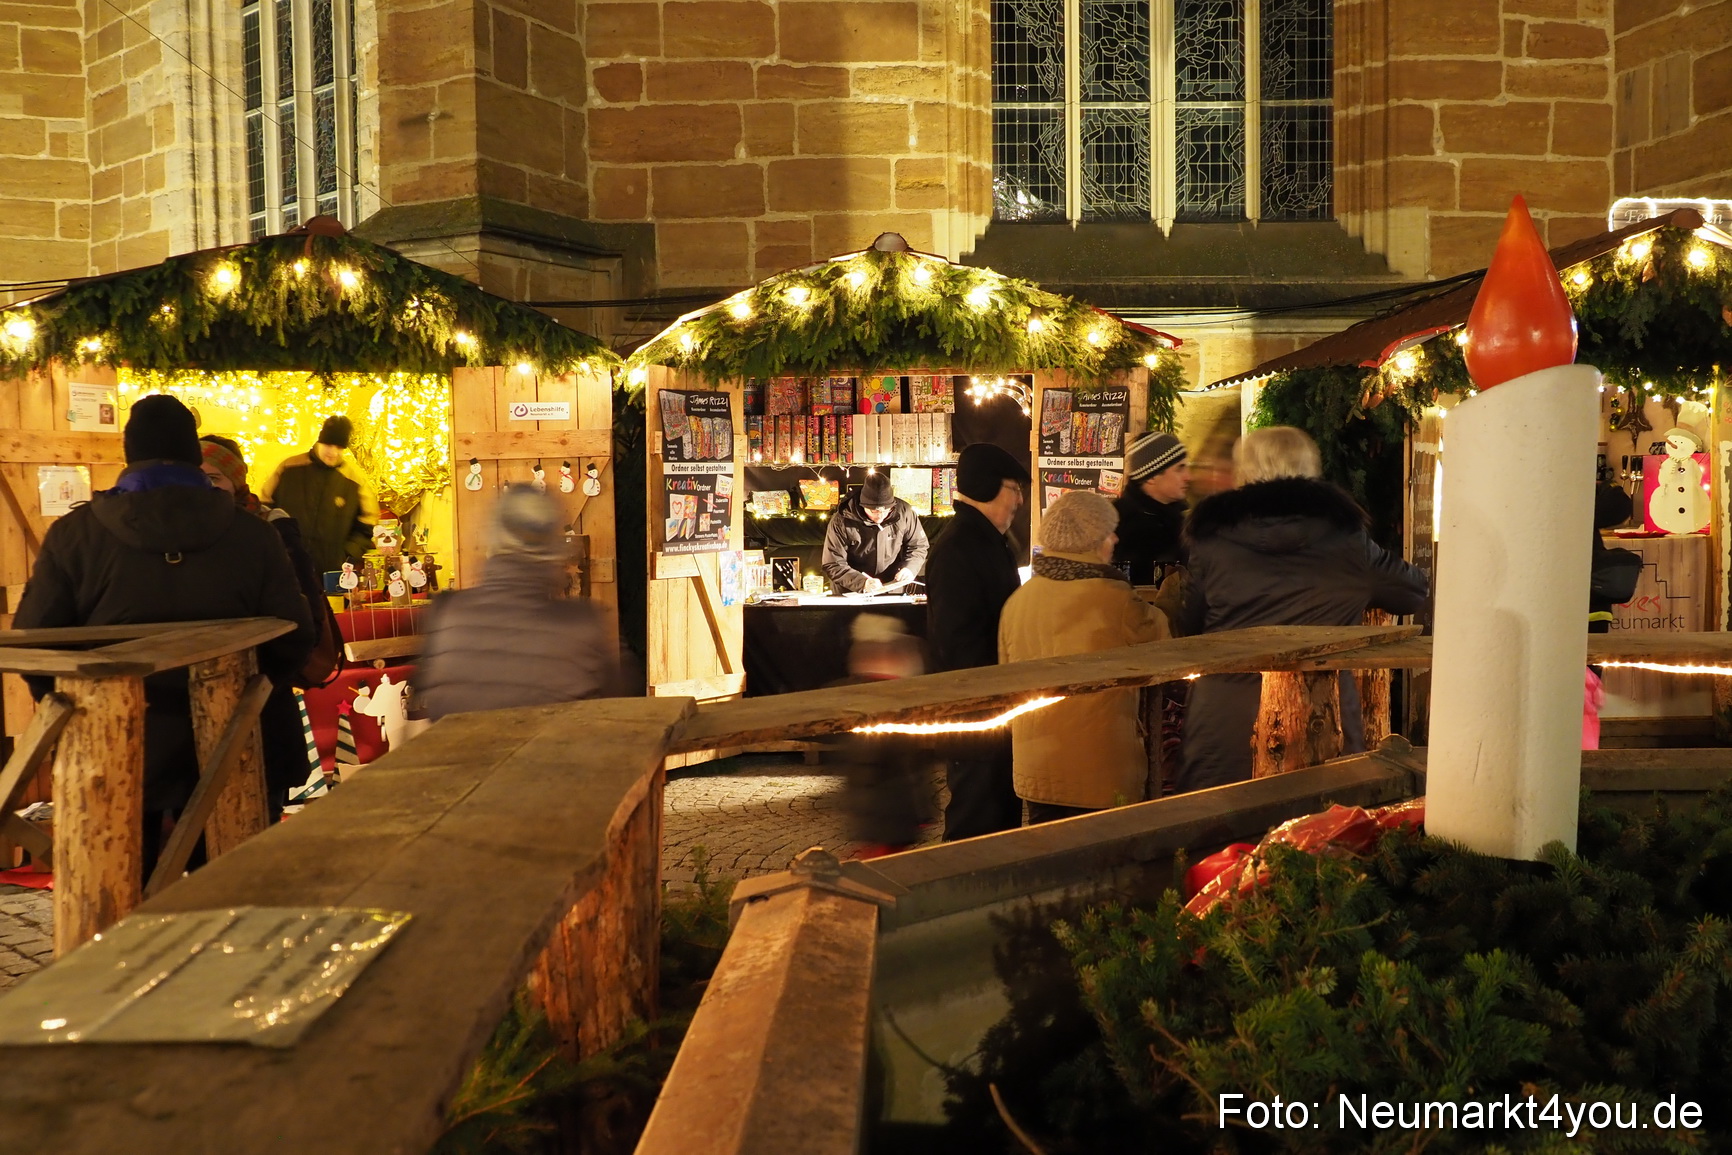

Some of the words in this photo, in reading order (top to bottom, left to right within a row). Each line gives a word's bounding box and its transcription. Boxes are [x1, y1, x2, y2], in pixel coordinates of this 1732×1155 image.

[1046, 458, 1066, 466] Ordner
[1067, 458, 1085, 467] selbst
[1086, 459, 1114, 468] gestalten
[671, 464, 689, 472] Ordner
[690, 464, 705, 472] selbst
[705, 464, 727, 473] gestalten
[1610, 613, 1685, 630] eumarkt
